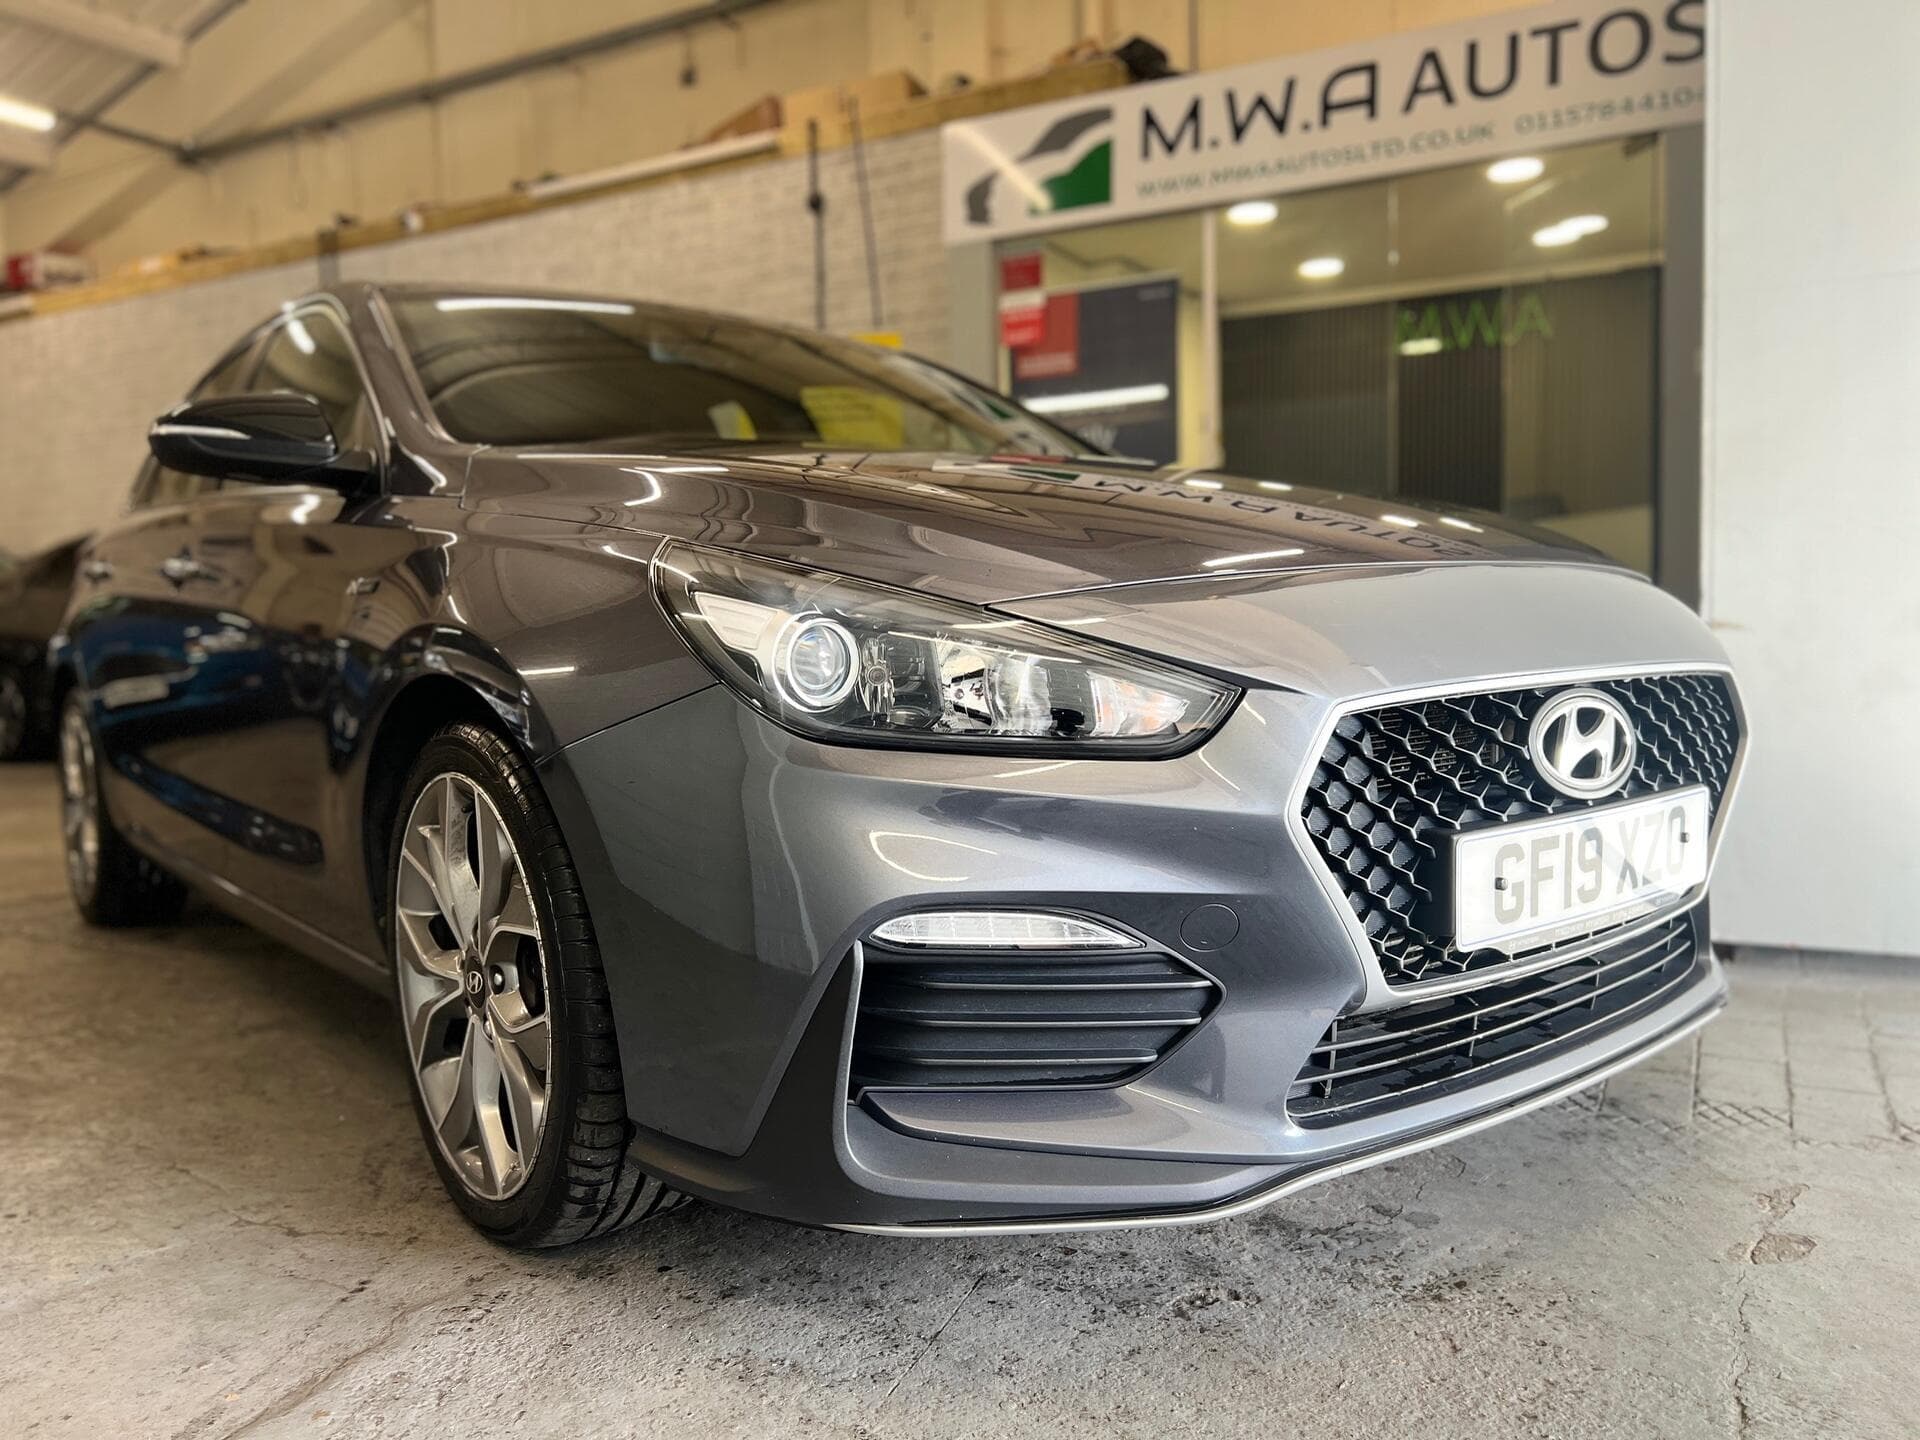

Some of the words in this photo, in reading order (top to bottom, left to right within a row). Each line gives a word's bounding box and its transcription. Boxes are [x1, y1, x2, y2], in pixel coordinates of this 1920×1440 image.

[1143, 61, 1377, 160] M.W.A
[1403, 0, 1705, 113] AUTOS
[1494, 827, 1604, 924] GF19
